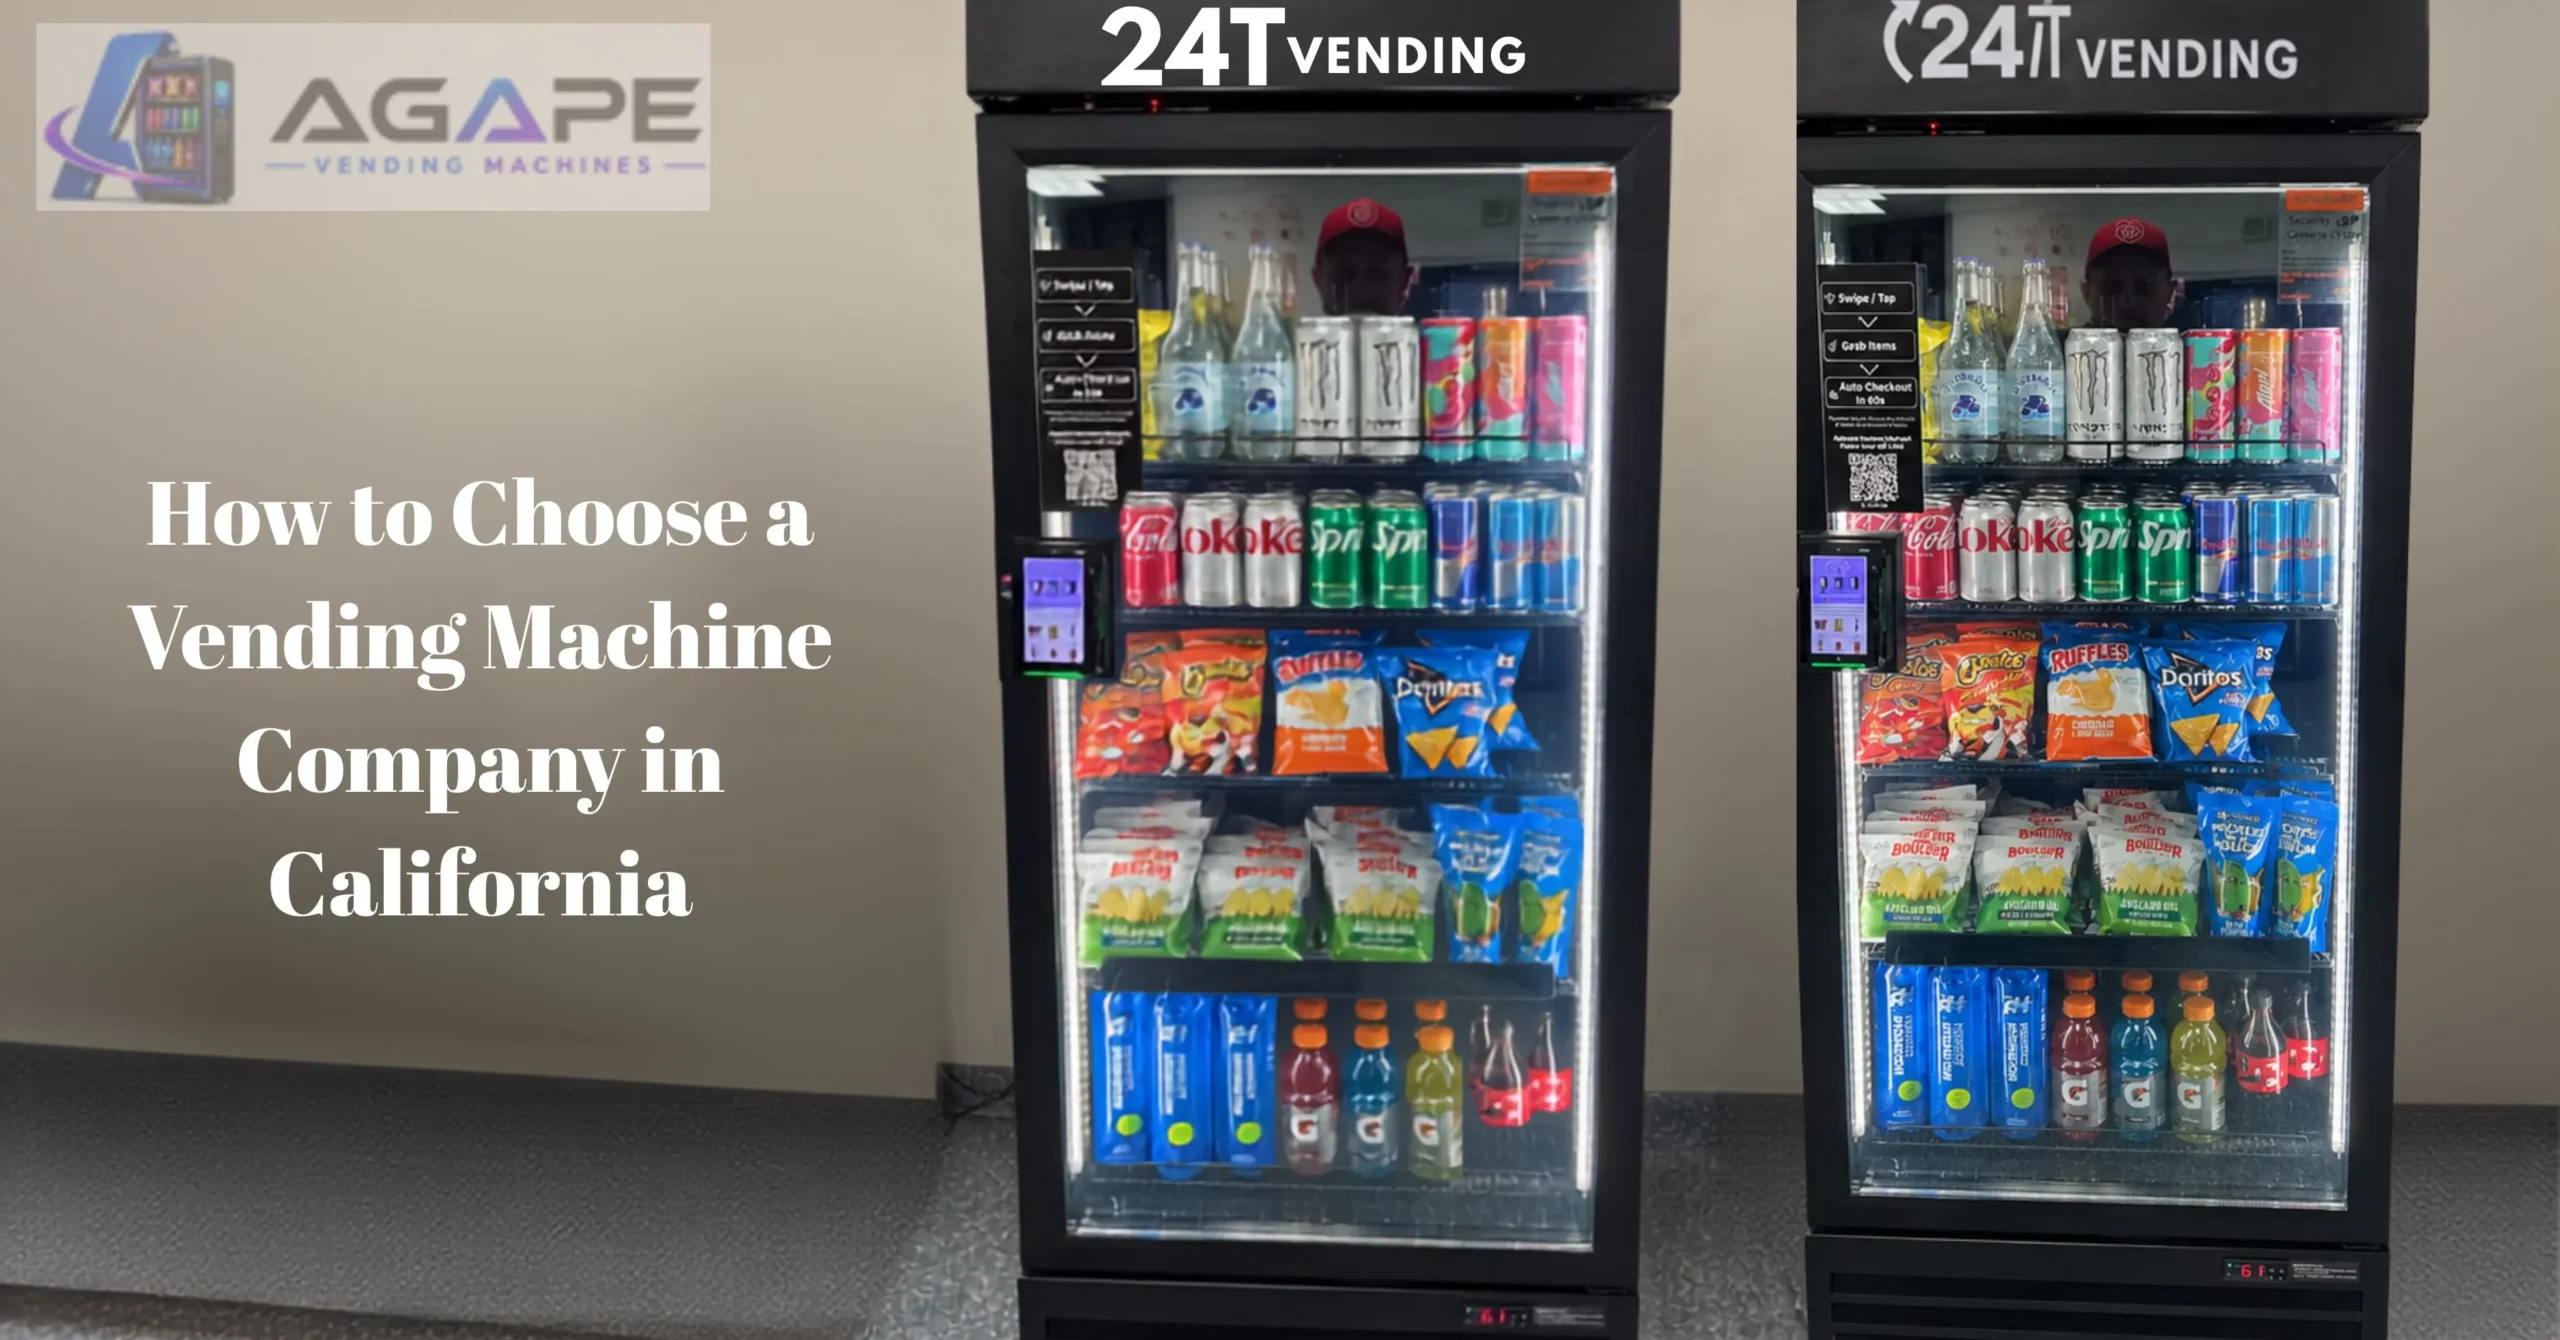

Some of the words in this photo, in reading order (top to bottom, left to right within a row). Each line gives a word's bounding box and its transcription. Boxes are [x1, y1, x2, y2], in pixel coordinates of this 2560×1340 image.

[1286, 36, 1526, 75] VENDING
[2076, 38, 2299, 79] VENDING
[1838, 292, 1869, 306] Swipe
[1877, 292, 1897, 305] Tap
[1868, 340, 1897, 351] Items
[1839, 381, 1863, 392] Auto
[1864, 382, 1913, 393] Checkout
[2049, 643, 2129, 674] RUFFLES
[2161, 668, 2242, 687] Doritos
